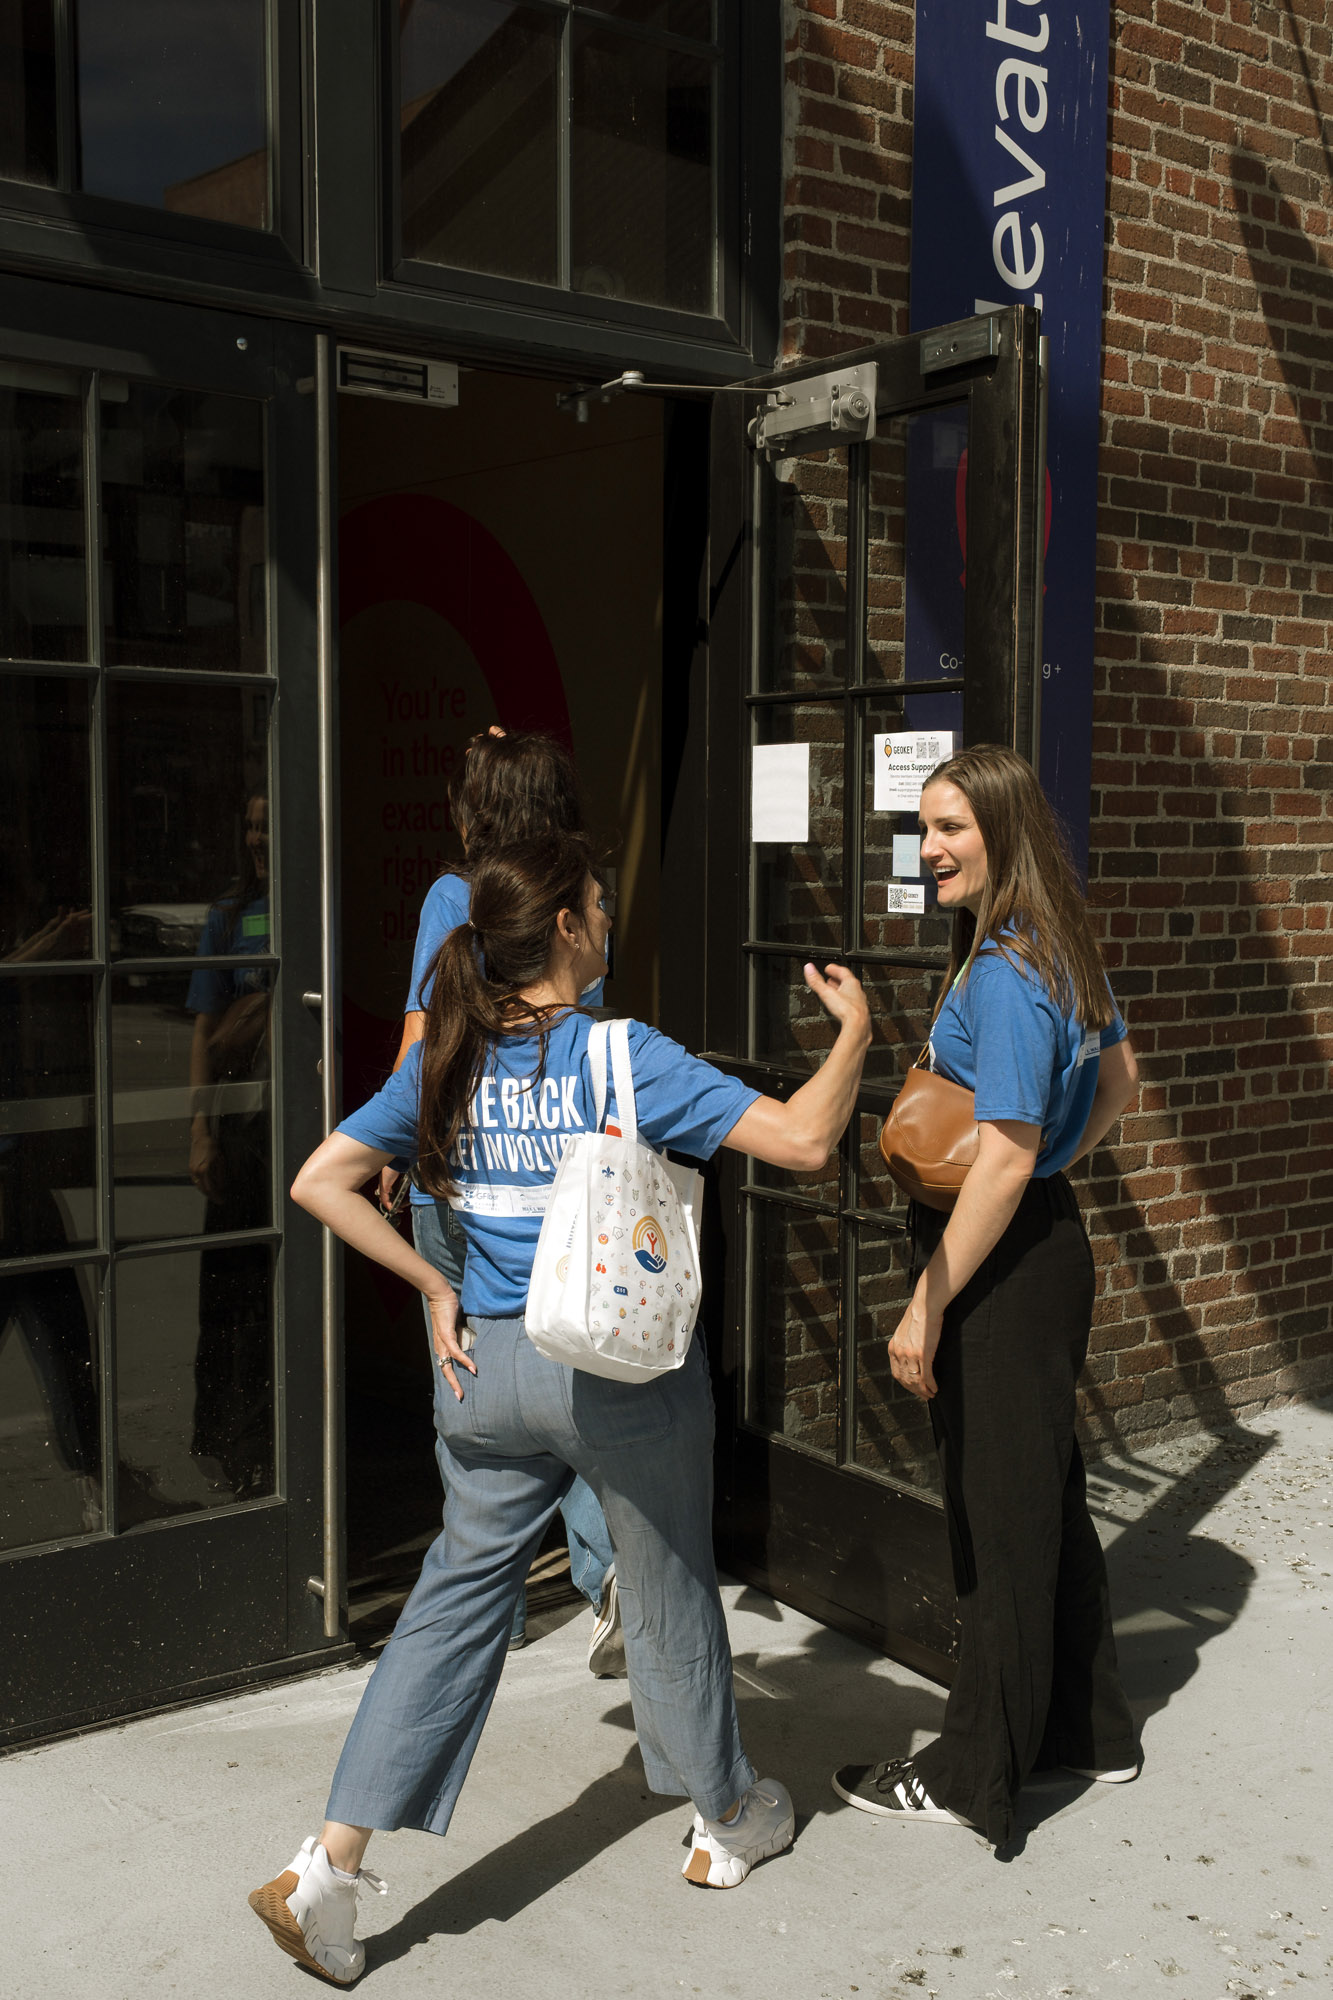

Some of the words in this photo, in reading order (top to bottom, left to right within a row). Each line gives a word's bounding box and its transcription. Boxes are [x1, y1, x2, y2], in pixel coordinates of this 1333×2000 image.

[380, 675, 467, 723] You're
[381, 735, 404, 777] in
[411, 733, 456, 777] the
[888, 763, 910, 771] Access
[893, 745, 914, 755] GEOKEY
[501, 1075, 585, 1130] BACK
